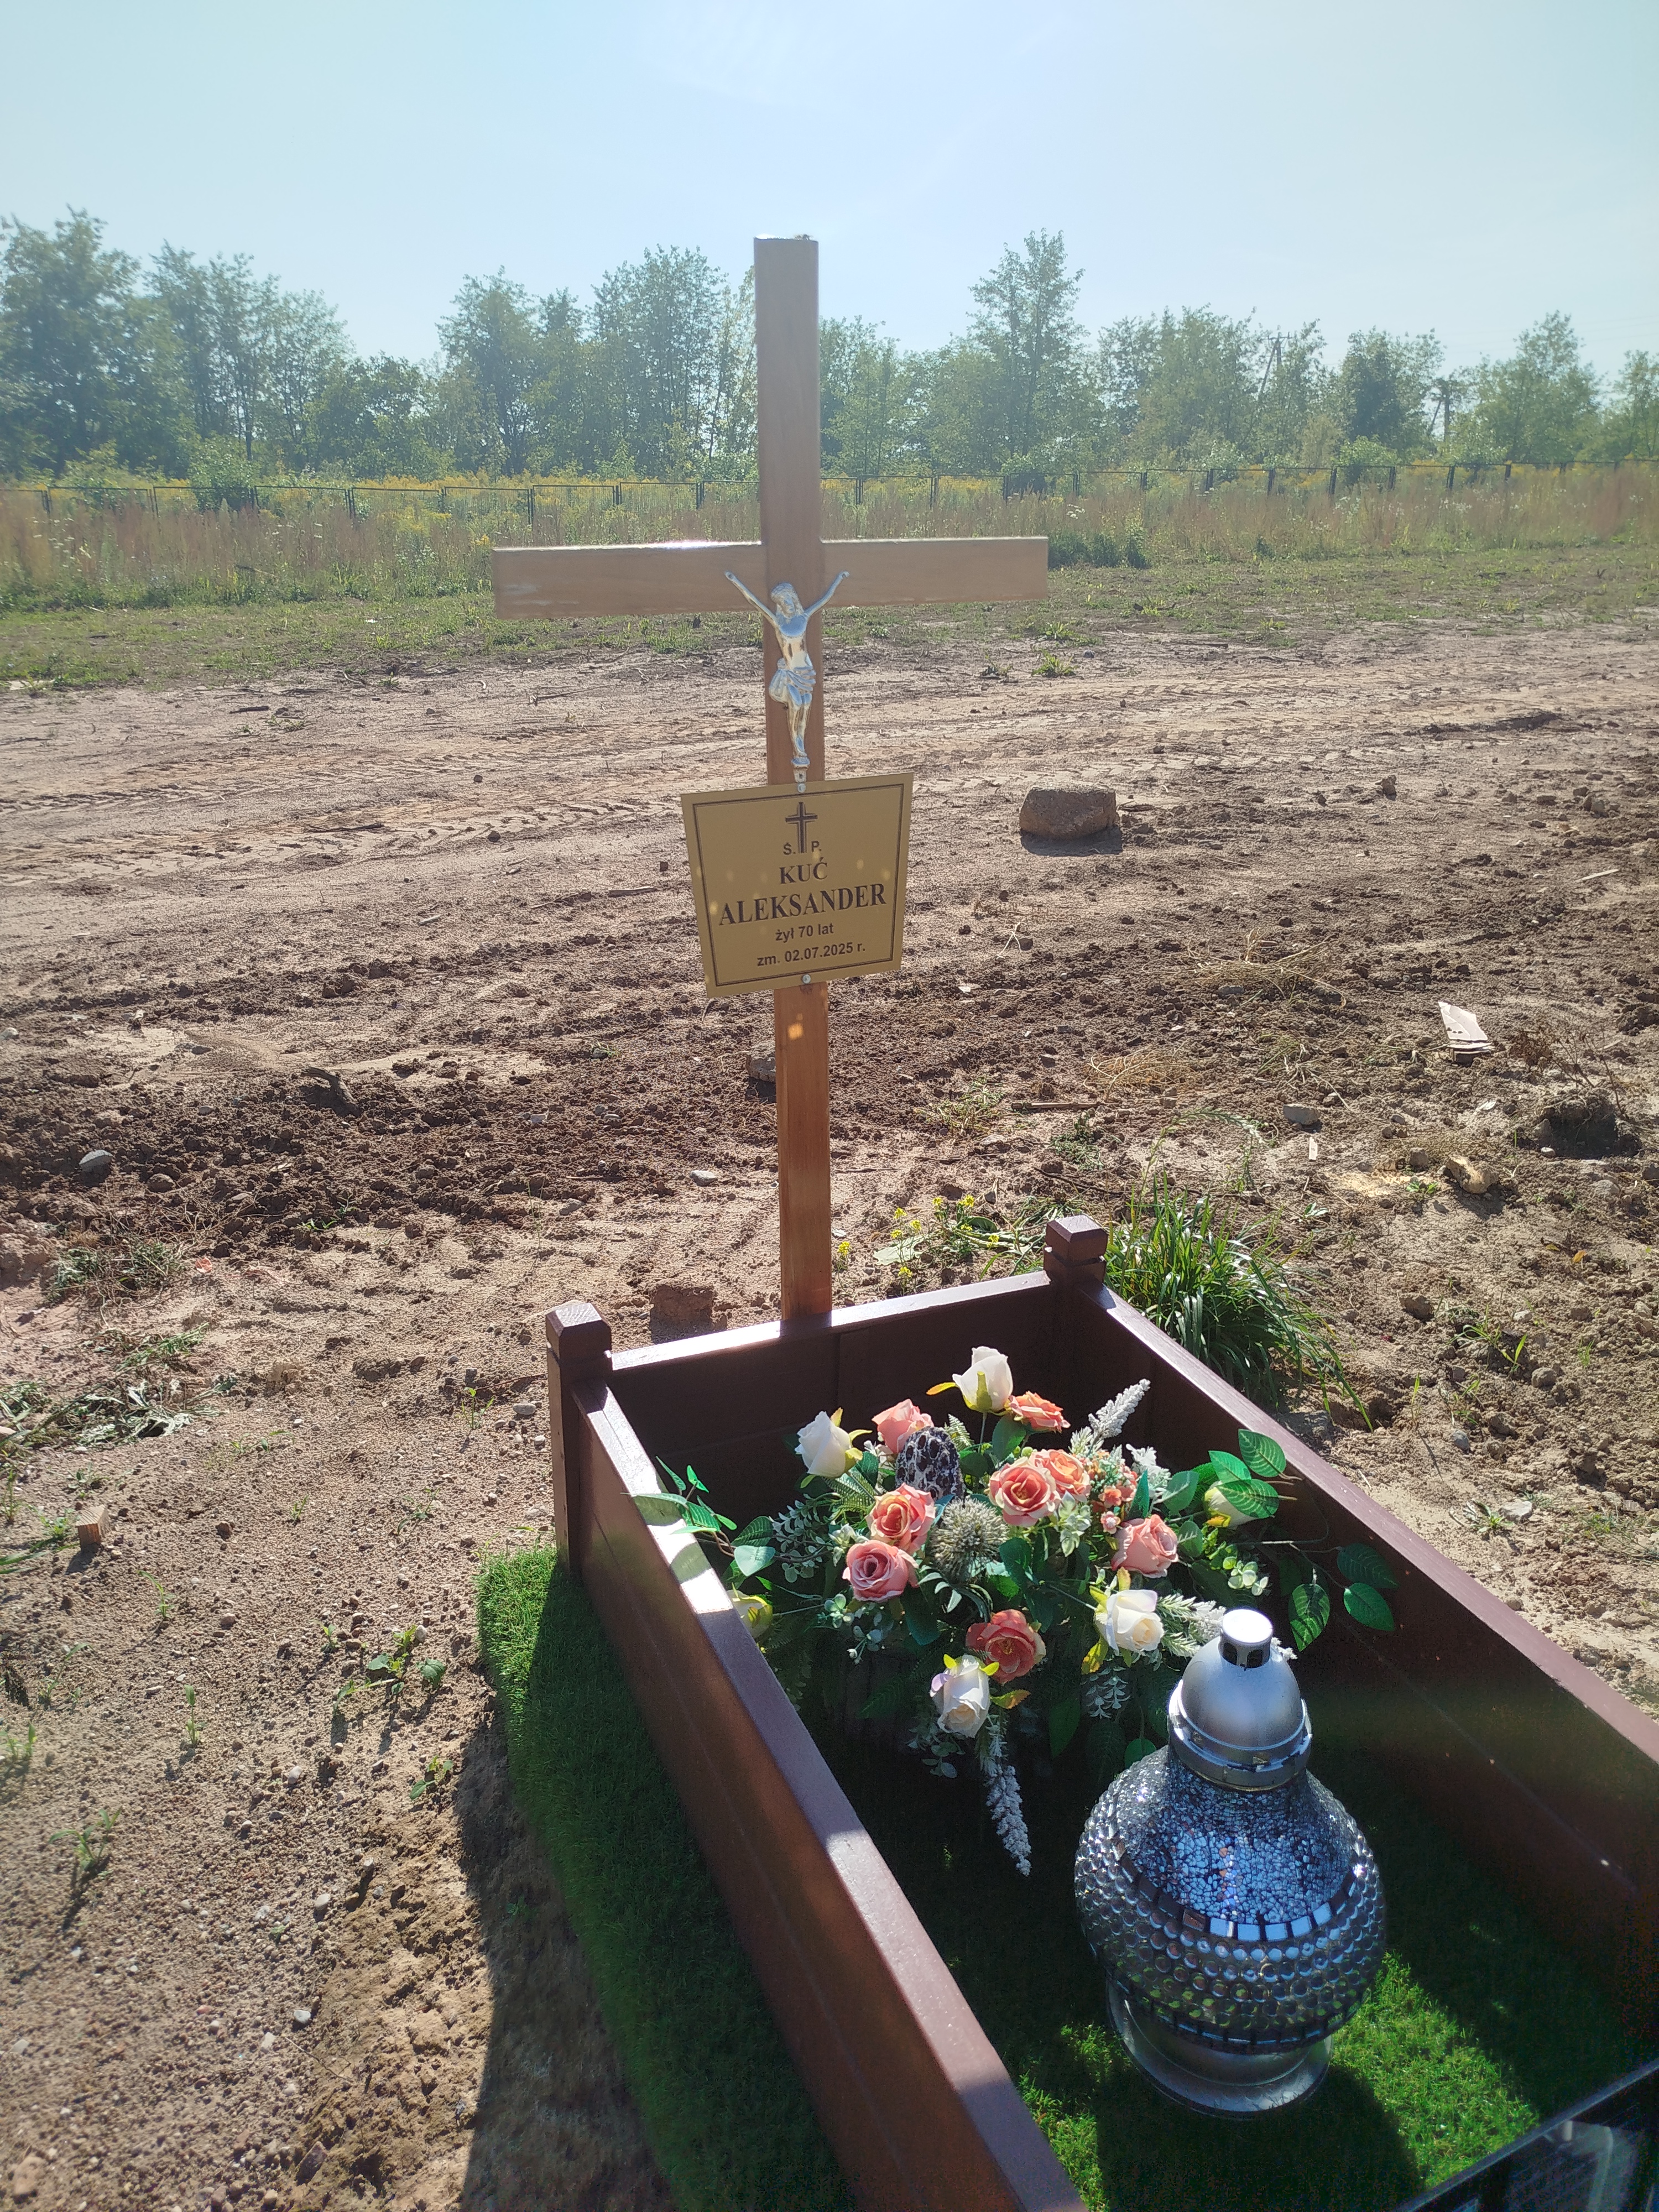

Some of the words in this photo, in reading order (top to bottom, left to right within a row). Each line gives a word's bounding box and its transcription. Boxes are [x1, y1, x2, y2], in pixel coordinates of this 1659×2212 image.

[811, 841, 822, 852] P.
[779, 857, 828, 884] KUĆ
[719, 883, 887, 926] ALEKSANDER
[775, 927, 794, 943] żył
[798, 925, 813, 937] 70
[818, 923, 834, 935] lat
[757, 955, 780, 966] zm.
[785, 942, 853, 962] 02.07.2025
[857, 943, 865, 952] r.
